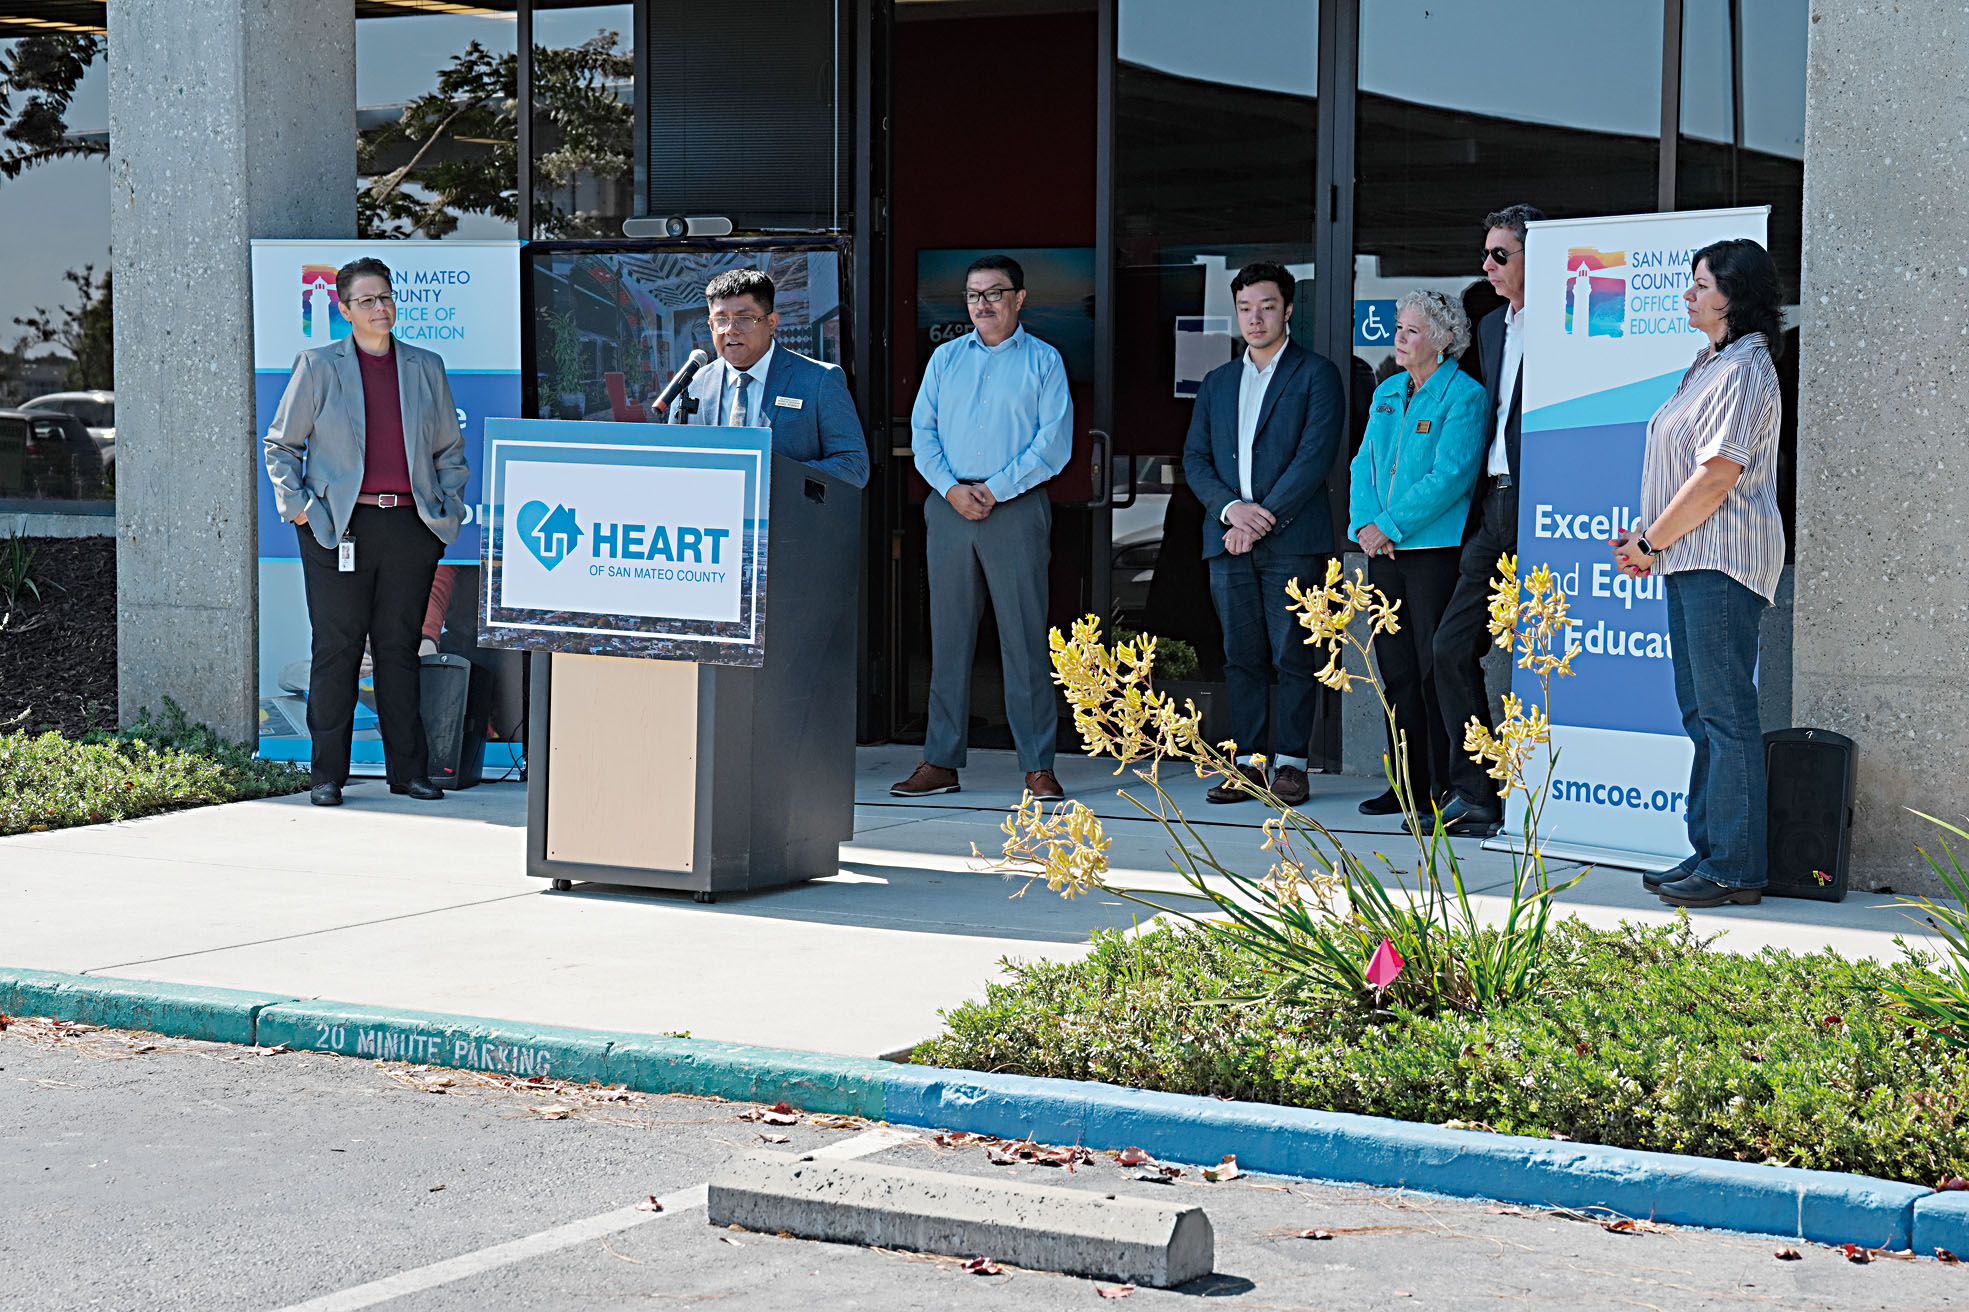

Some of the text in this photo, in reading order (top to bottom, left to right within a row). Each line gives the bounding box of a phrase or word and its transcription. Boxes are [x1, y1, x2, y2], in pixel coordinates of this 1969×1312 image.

[1632, 249, 1698, 268] SAN MAT
[414, 270, 470, 284] MATEO
[1631, 272, 1691, 290] COUNTY
[1630, 295, 1679, 312] OFFICE
[397, 307, 456, 321] FICE OF
[391, 325, 465, 339] UCATION
[1630, 317, 1702, 334] EDUCATI
[1535, 504, 1641, 540] Excell
[592, 522, 730, 564] HEART
[589, 565, 726, 583] OF SAN MATEO COUNTY
[1546, 562, 1663, 609] nd Equi
[1564, 619, 1672, 659] Educat
[316, 1025, 551, 1076] 20 MINUTE PARKING
